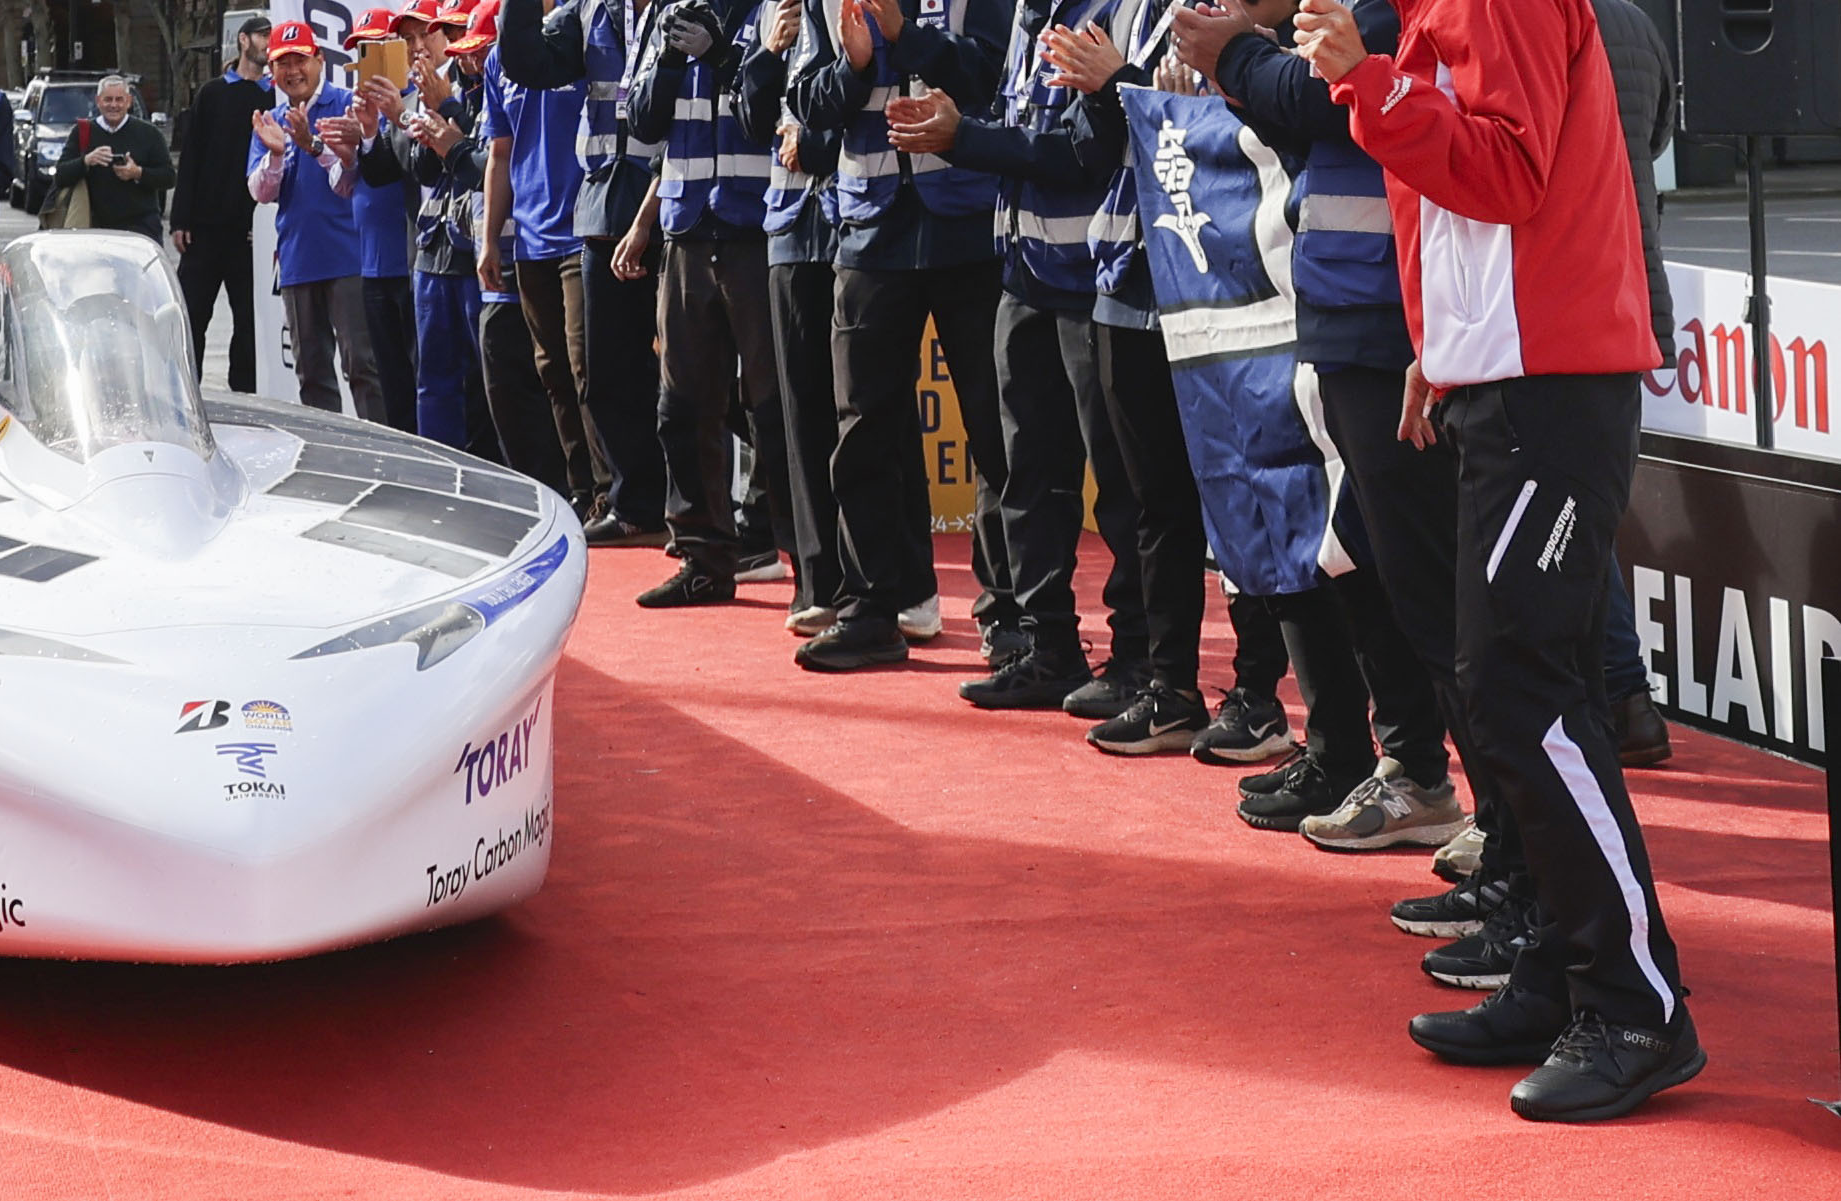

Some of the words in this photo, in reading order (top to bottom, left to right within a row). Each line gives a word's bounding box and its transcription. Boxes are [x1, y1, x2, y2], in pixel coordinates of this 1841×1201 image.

[1643, 318, 1830, 434] anon
[224, 781, 286, 795] TOKAI
[225, 791, 287, 801] UNIVERSITY
[426, 863, 471, 908] Toray
[474, 836, 521, 881] Carbon
[523, 793, 550, 850] Magic
